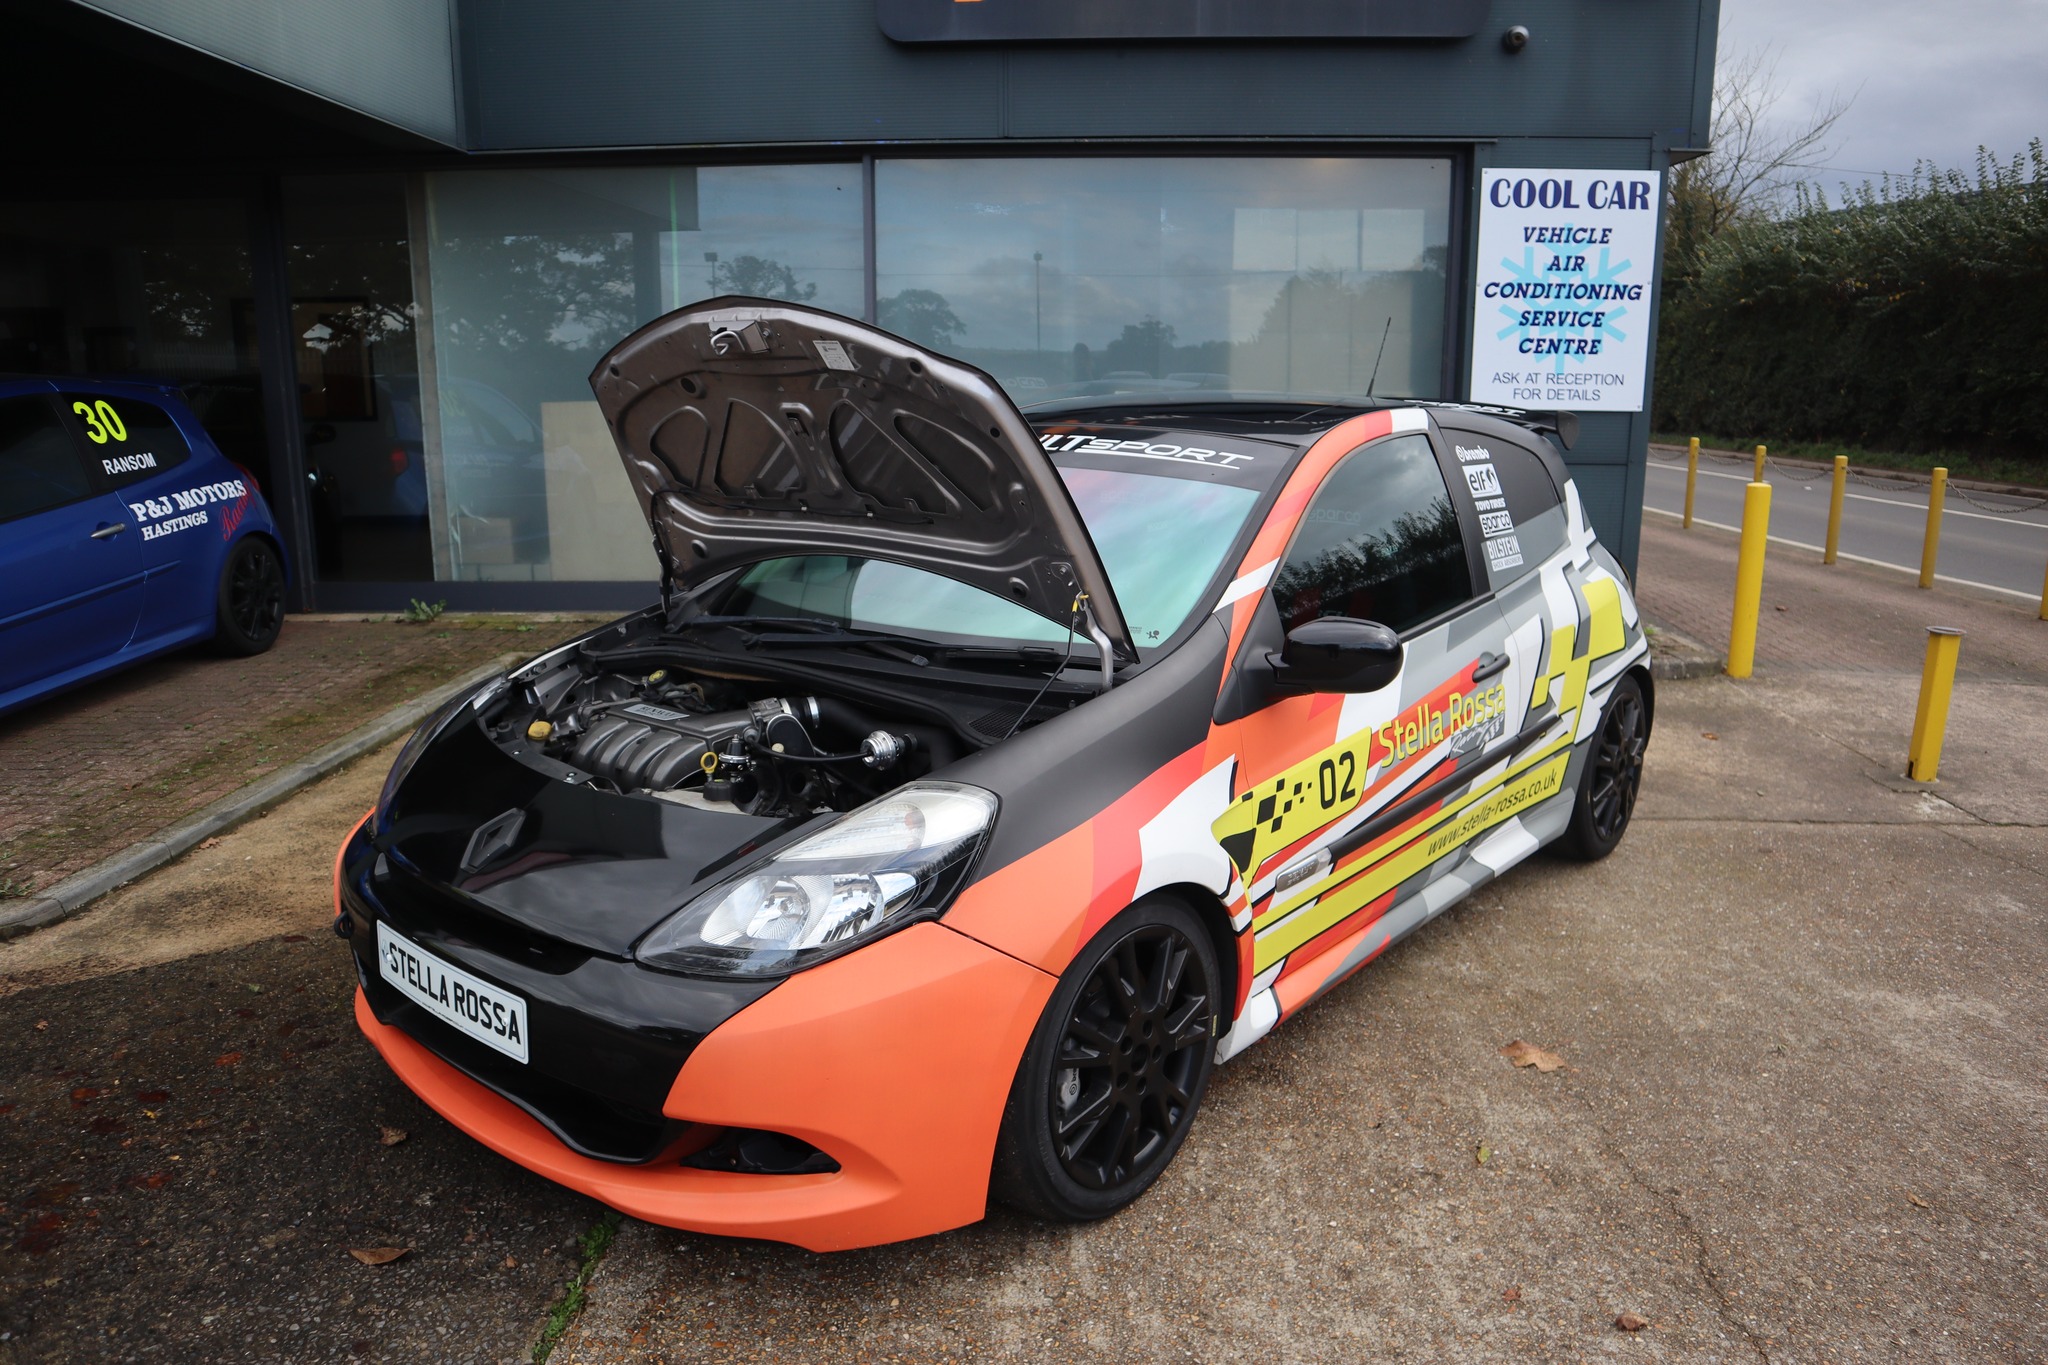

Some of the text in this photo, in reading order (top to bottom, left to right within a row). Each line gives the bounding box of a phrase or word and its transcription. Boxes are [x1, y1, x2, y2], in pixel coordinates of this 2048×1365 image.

[1490, 178, 1651, 210] COOL CAR
[1523, 227, 1612, 244] VEHICLE
[1547, 255, 1585, 272] AIR
[1484, 282, 1643, 301] CONDITIONING
[1518, 310, 1605, 328] SERVICE
[1518, 338, 1602, 355] CENTRE
[1492, 372, 1625, 386] ASK AT RECEPTION
[1513, 388, 1601, 401] FOR DETAILS
[73, 400, 127, 444] 30
[102, 452, 157, 475] RANSOM
[1461, 445, 1490, 460] brembo
[1469, 468, 1486, 492] elf
[129, 479, 247, 522] P&J MOTORS
[141, 510, 208, 541] HASTINGS
[1482, 513, 1511, 531] sparco
[1486, 536, 1520, 559] BILSTEIN
[1379, 684, 1505, 768] Stella Rossa
[1319, 751, 1356, 810] 02
[1428, 768, 1557, 857] www.stella-rossa.co.uk
[389, 942, 450, 1008] STELLA
[453, 981, 521, 1045] ROSSA
